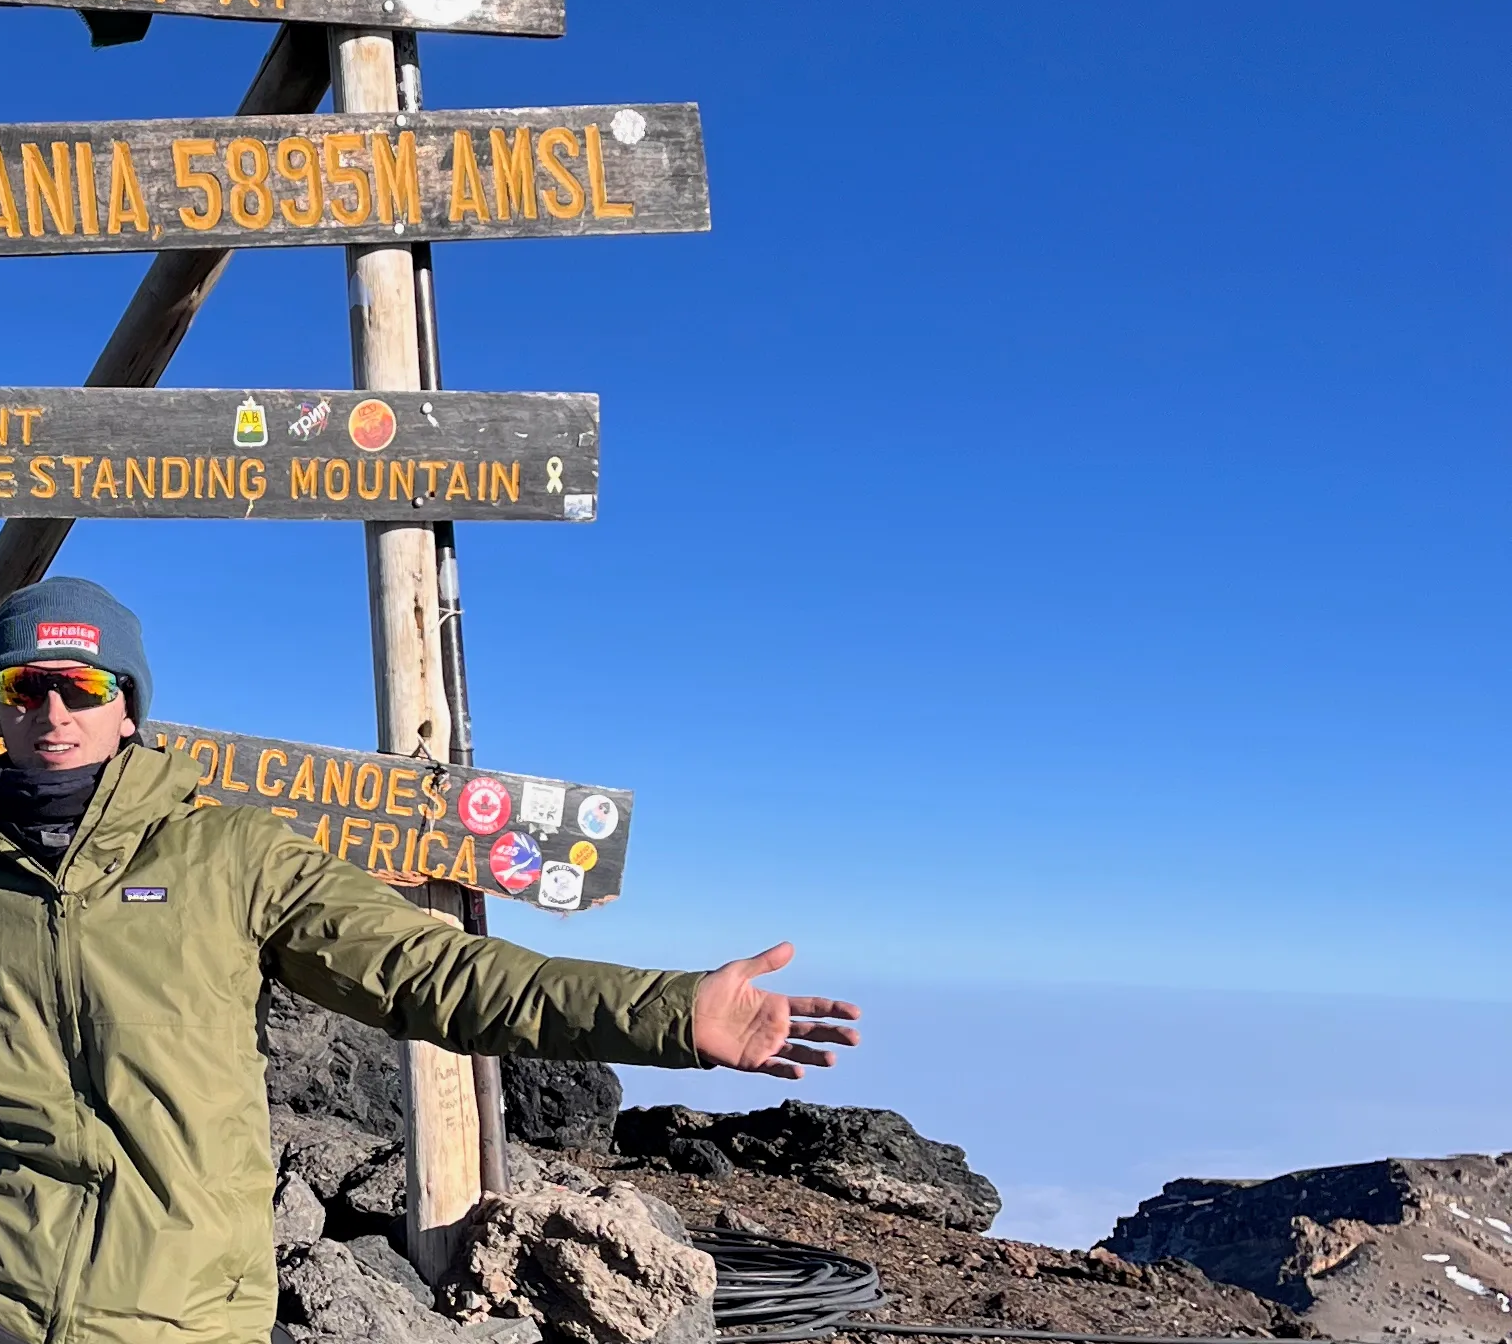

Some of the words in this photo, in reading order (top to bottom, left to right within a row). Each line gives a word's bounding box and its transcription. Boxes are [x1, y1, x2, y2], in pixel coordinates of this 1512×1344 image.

[171, 130, 423, 232] 5895M
[448, 125, 635, 223] AMSL
[29, 456, 267, 499] STANDING
[290, 458, 520, 501] MOUNTAIN
[41, 625, 96, 640] VERBIER
[155, 732, 450, 821] OLCANOES
[467, 778, 507, 800] CANADA
[312, 813, 478, 887] AFRICA
[546, 864, 581, 879] WELCOME
